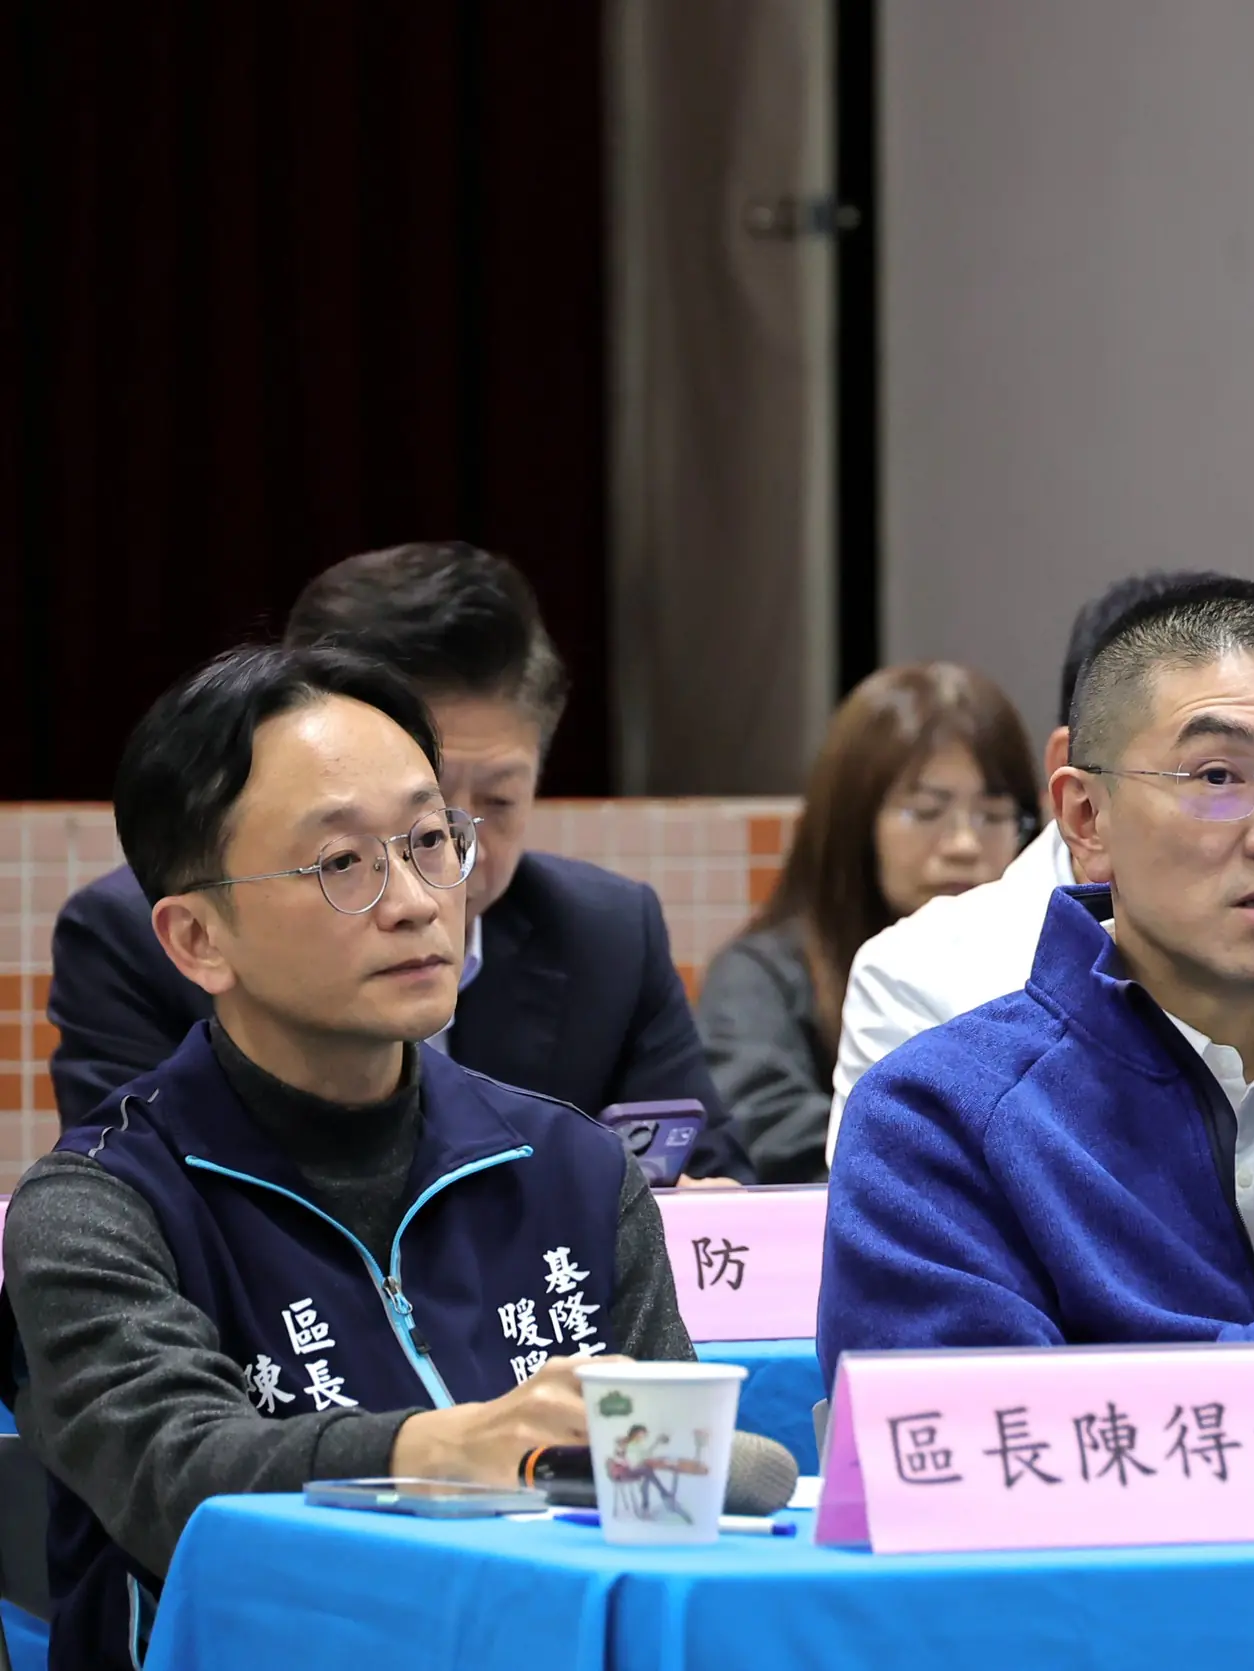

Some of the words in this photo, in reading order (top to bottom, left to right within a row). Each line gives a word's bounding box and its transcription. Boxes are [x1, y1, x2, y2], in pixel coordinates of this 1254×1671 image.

[691, 1237, 750, 1291] 防
[242, 1354, 296, 1413] 陳
[281, 1297, 359, 1411] 區長
